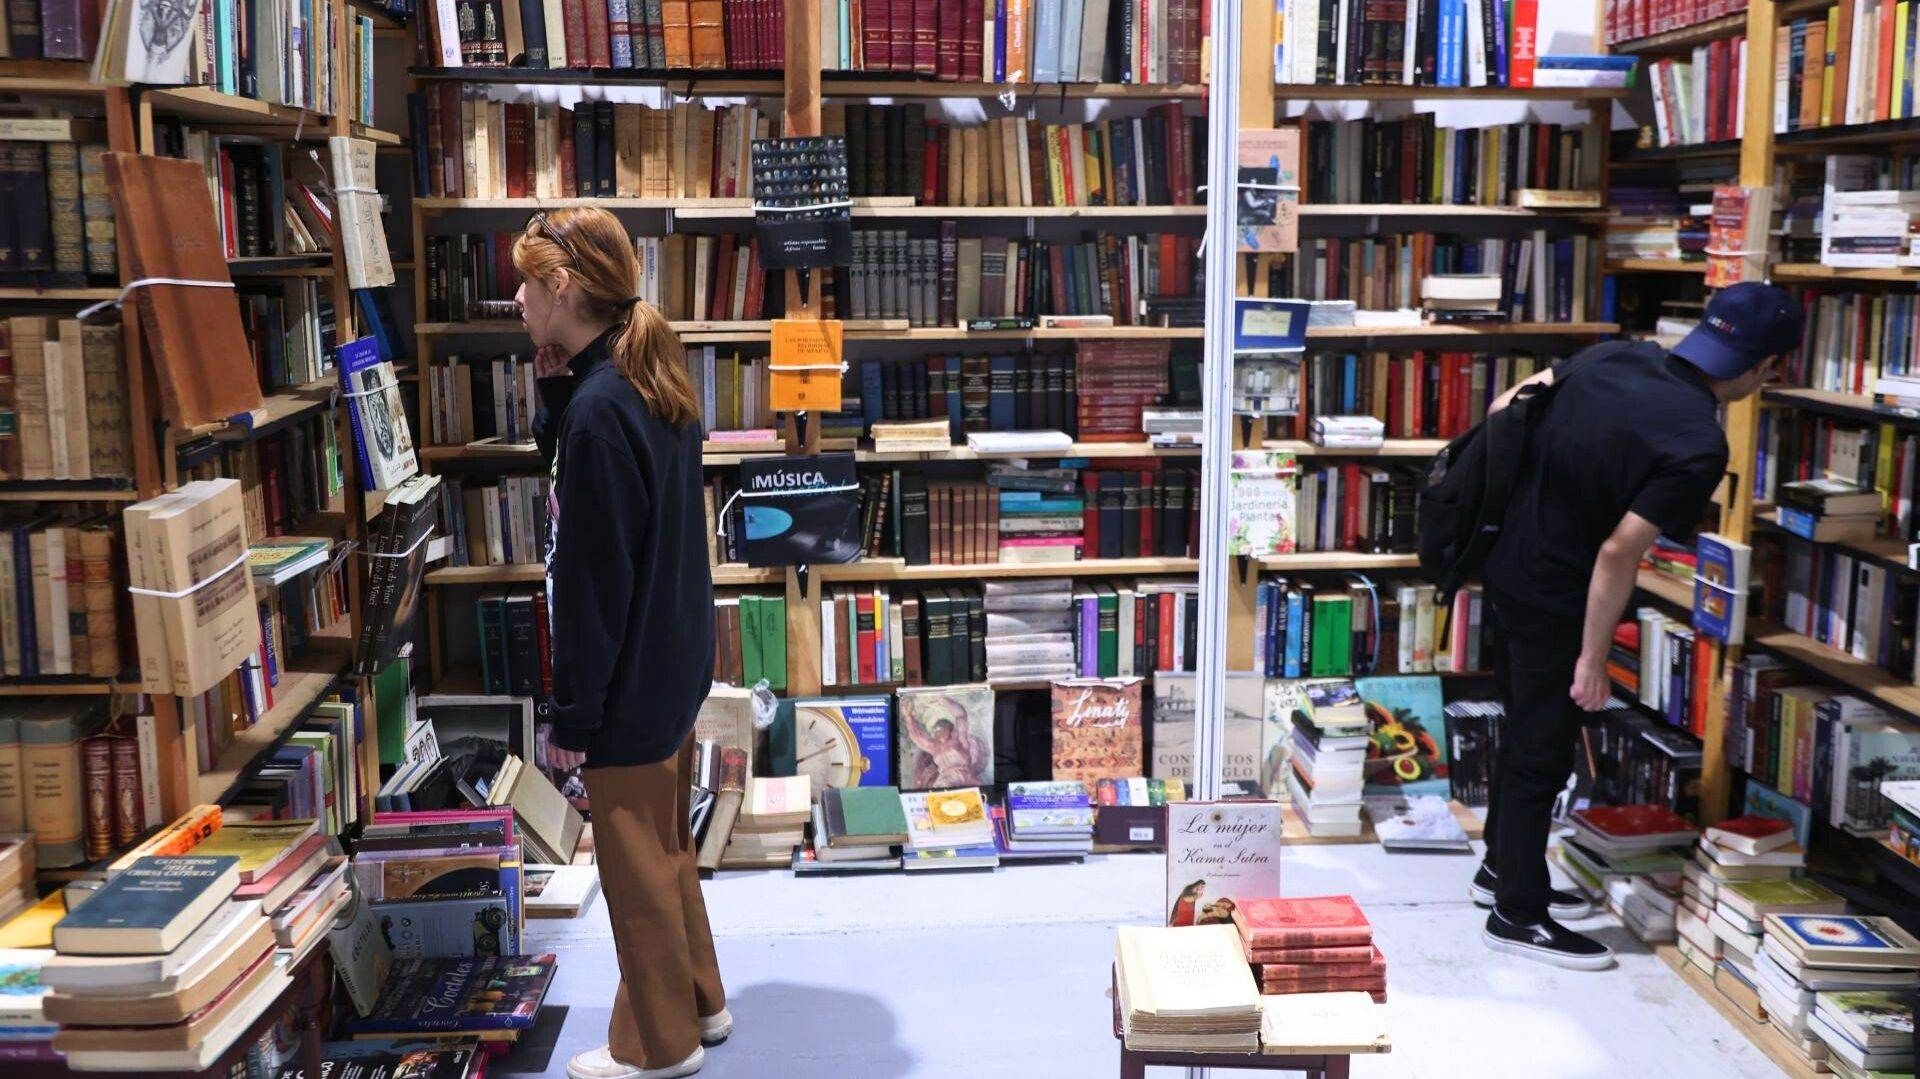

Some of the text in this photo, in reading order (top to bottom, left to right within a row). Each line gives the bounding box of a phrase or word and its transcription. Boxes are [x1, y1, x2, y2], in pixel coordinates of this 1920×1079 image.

[1177, 813, 1272, 842] La mujer
[1177, 848, 1271, 864] Kama Sutra
